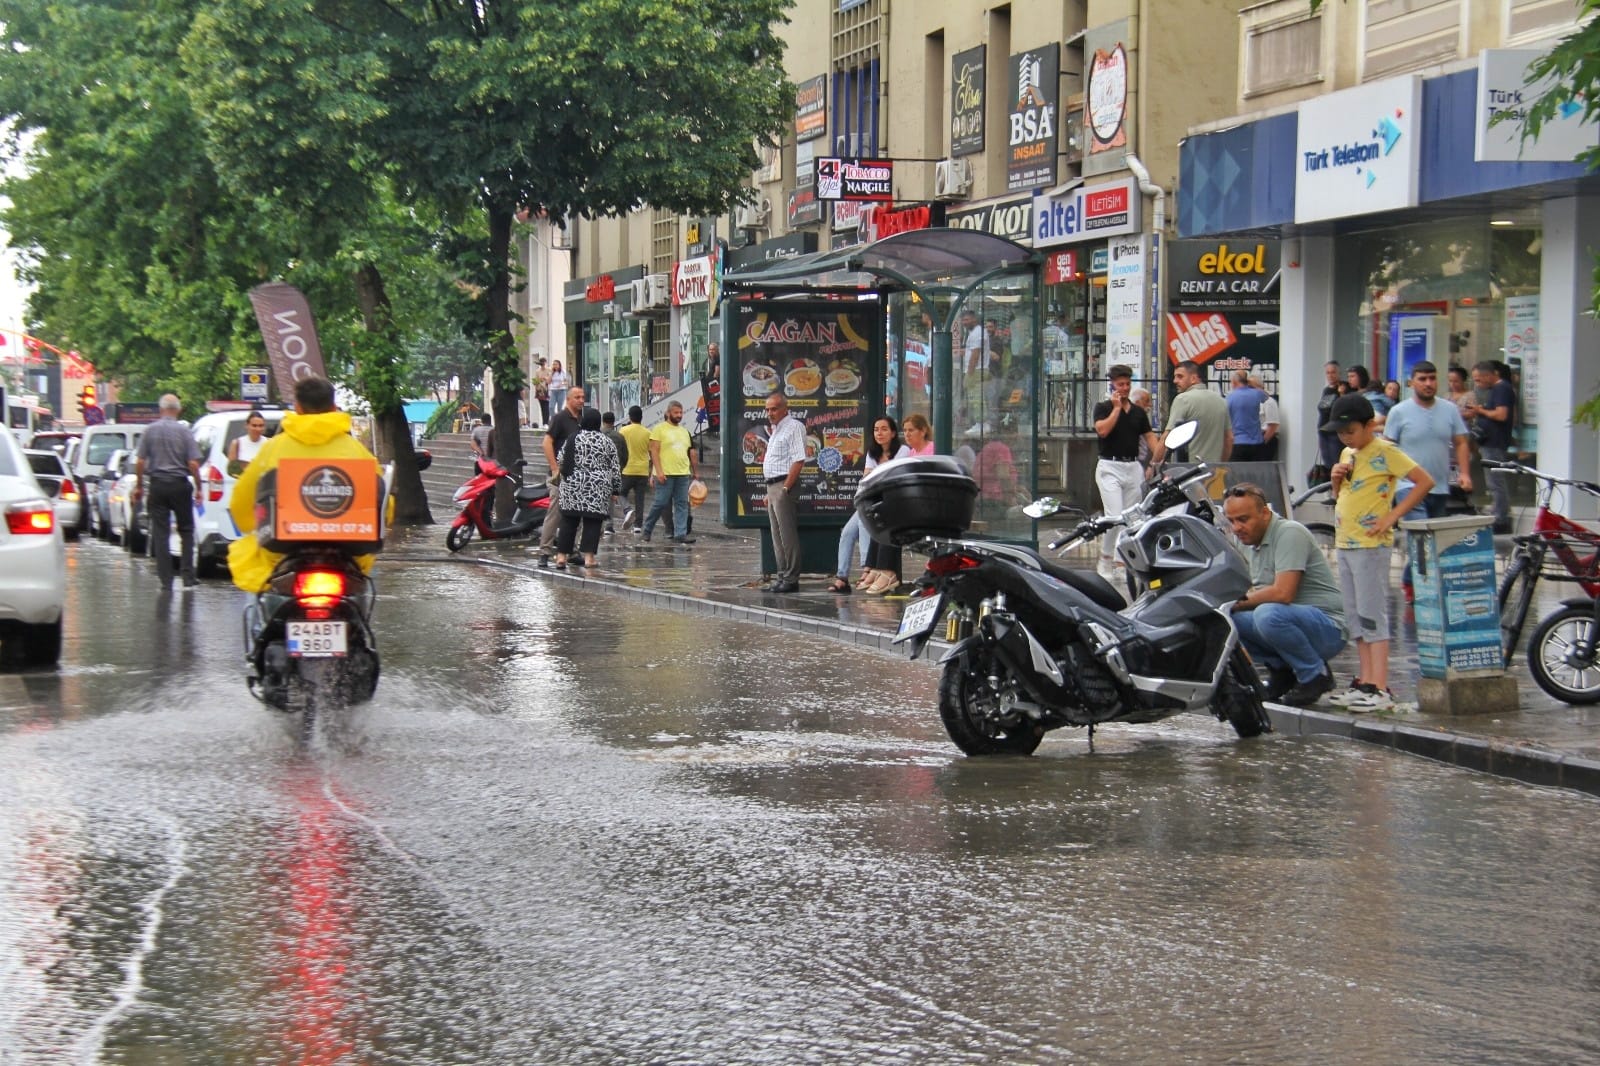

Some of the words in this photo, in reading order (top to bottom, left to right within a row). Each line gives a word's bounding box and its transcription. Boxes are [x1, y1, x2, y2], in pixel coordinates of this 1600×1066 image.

[1488, 89, 1522, 104] Türk
[1010, 106, 1053, 146] BSA
[843, 161, 890, 180] TOBACCO
[1304, 148, 1329, 172] Türk
[1332, 141, 1380, 167] Telekom
[993, 203, 1032, 236] KOT
[1038, 195, 1082, 239] altel
[1198, 244, 1265, 274] ekol
[1180, 281, 1214, 293] RENT
[1216, 281, 1227, 293] A
[1231, 281, 1259, 293] CAR
[746, 319, 838, 348] ÇAĞAN
[1167, 313, 1230, 363] akbaş
[1214, 356, 1252, 370] erkek
[292, 624, 342, 636] 24ABT
